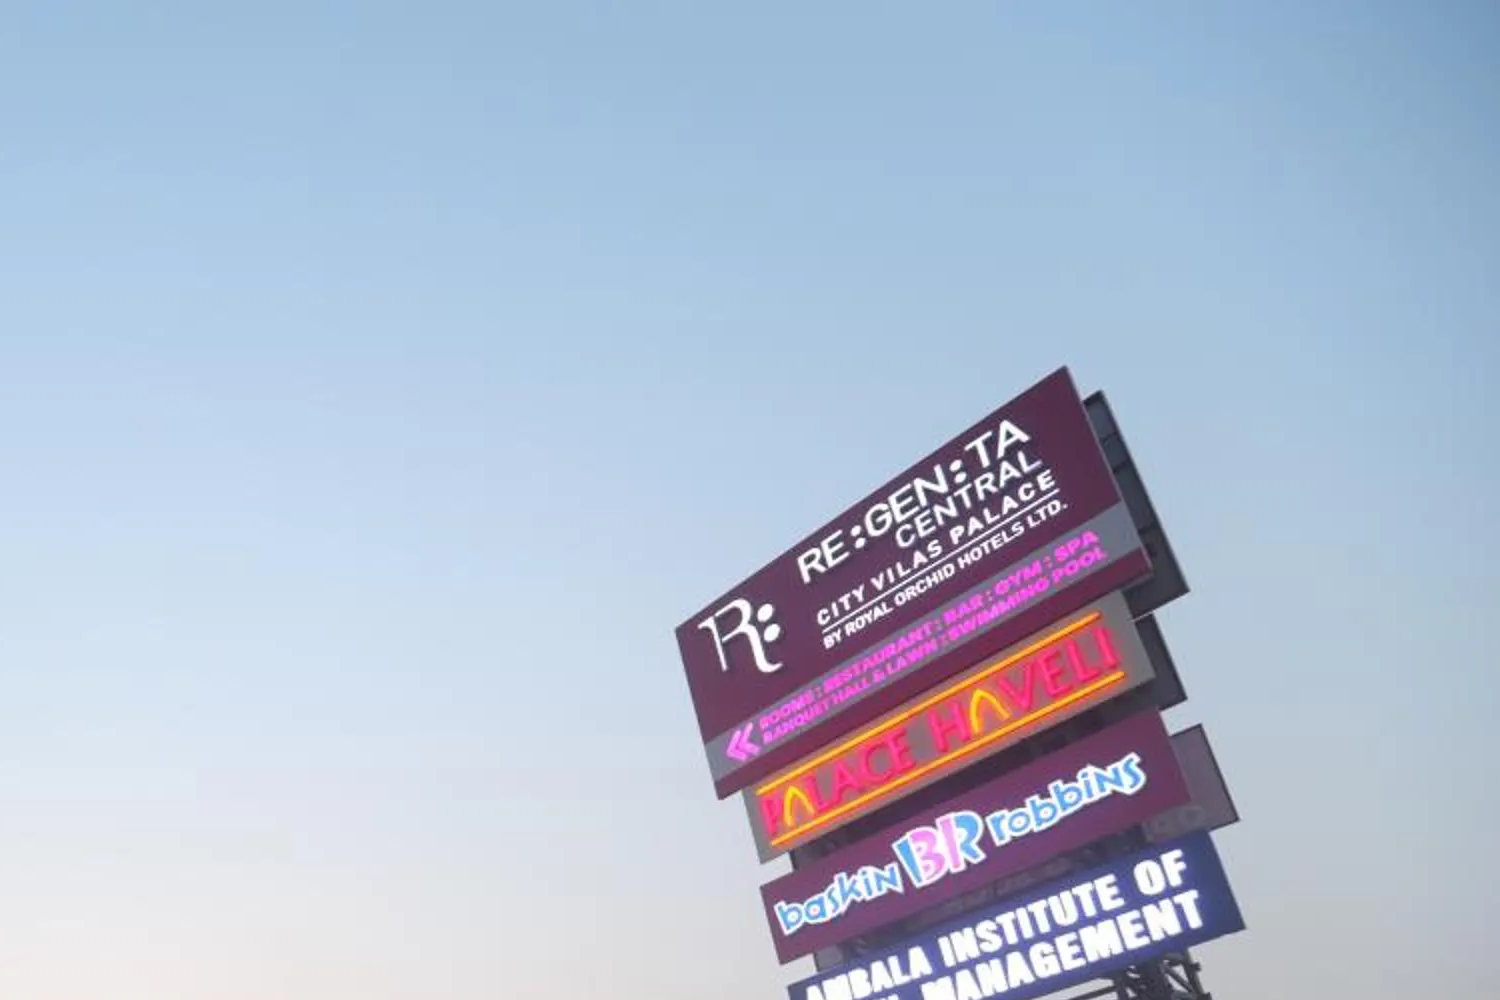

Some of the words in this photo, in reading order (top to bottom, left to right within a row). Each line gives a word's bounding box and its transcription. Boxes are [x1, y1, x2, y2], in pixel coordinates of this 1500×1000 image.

[797, 420, 1031, 584] RE:GEN:TA
[817, 585, 865, 625] CITY
[871, 539, 942, 591] VILAS
[949, 469, 1055, 544] PALACE
[823, 630, 843, 650] BY
[845, 601, 894, 637] ROYAL
[894, 562, 956, 606] ORCHID
[958, 523, 1025, 570] HOTELS
[1027, 498, 1068, 527] LTD.
[896, 451, 1042, 548] CENTRAL
[760, 690, 814, 730] ROOMS
[823, 620, 933, 692] RESTAURANT
[943, 594, 983, 624] BAR
[994, 559, 1043, 595] GYM
[1054, 530, 1098, 562] SPA
[762, 700, 828, 745] BANQUET
[831, 679, 869, 705] HALL
[872, 668, 887, 683] &
[886, 639, 937, 675] LAWN
[948, 576, 1050, 640] SWIMMING
[1053, 547, 1108, 584] POOL
[759, 727, 916, 836] PALACE
[928, 626, 1122, 751] HAVELI
[893, 812, 985, 887] BR
[938, 872, 1124, 967] INSTITUTE
[1133, 849, 1188, 895] OF
